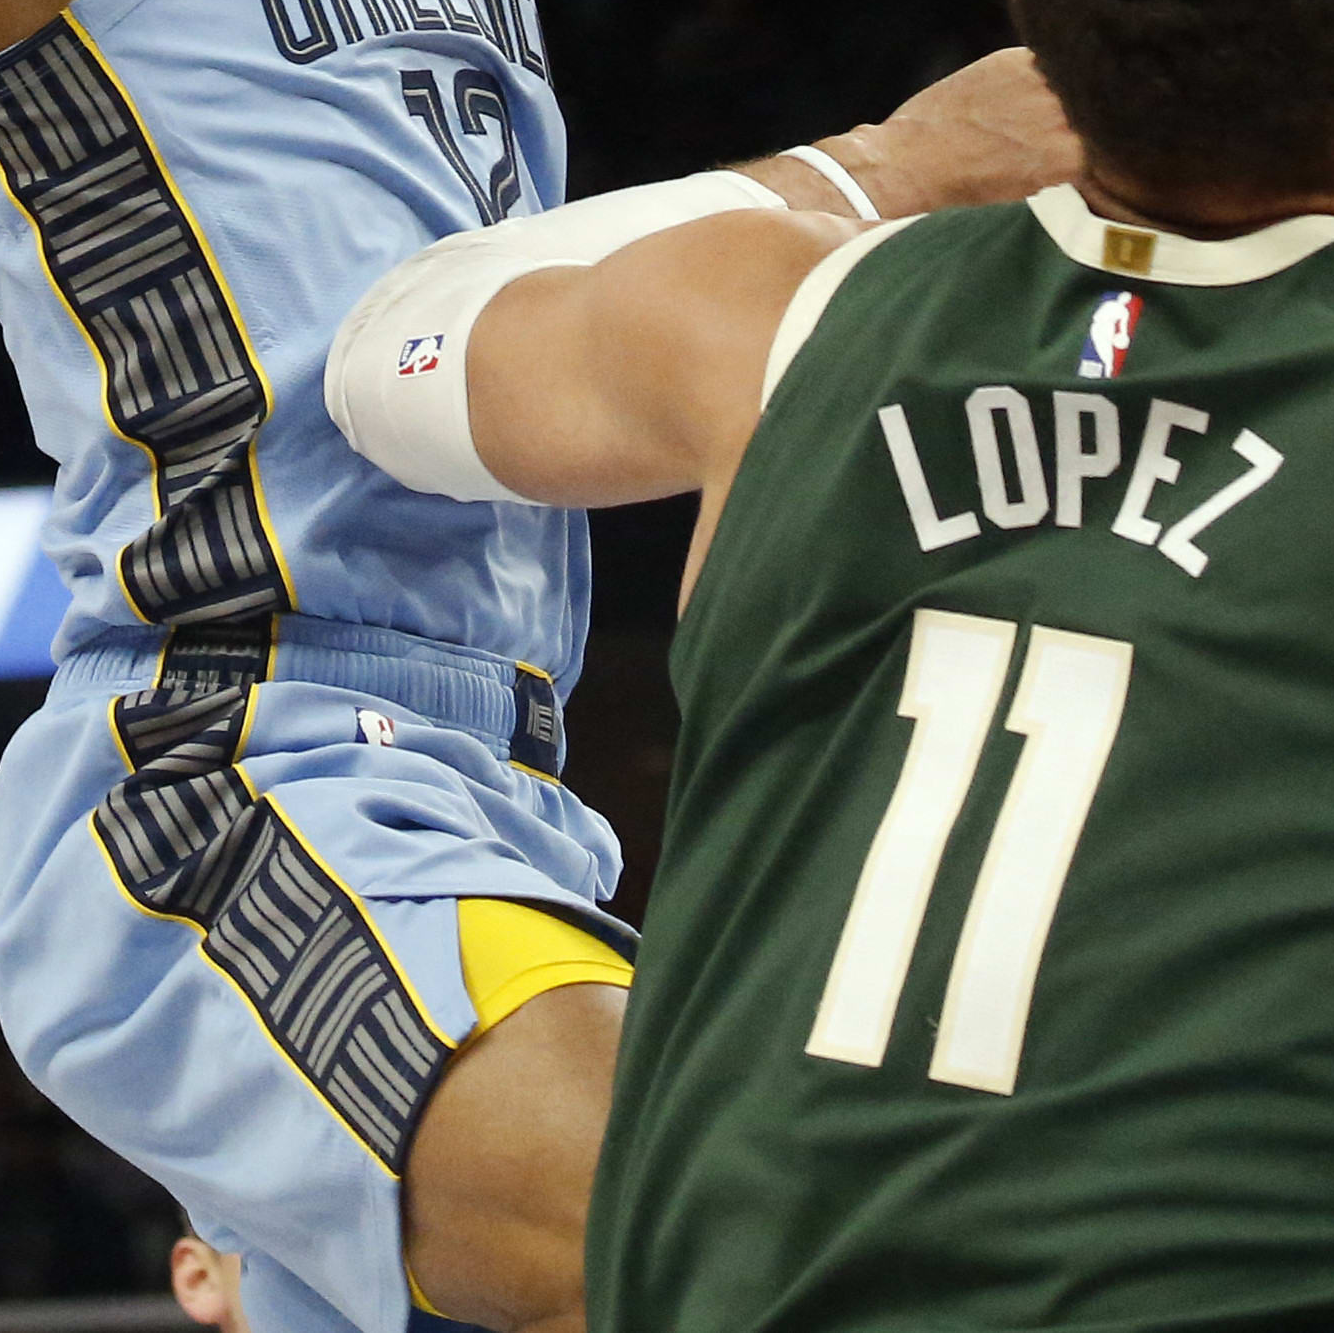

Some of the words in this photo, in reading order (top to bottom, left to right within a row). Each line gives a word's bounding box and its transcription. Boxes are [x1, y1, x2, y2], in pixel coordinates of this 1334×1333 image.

[400, 69, 521, 227] 12
[877, 386, 1284, 578] LOPEZ
[805, 608, 1133, 1096] 11
